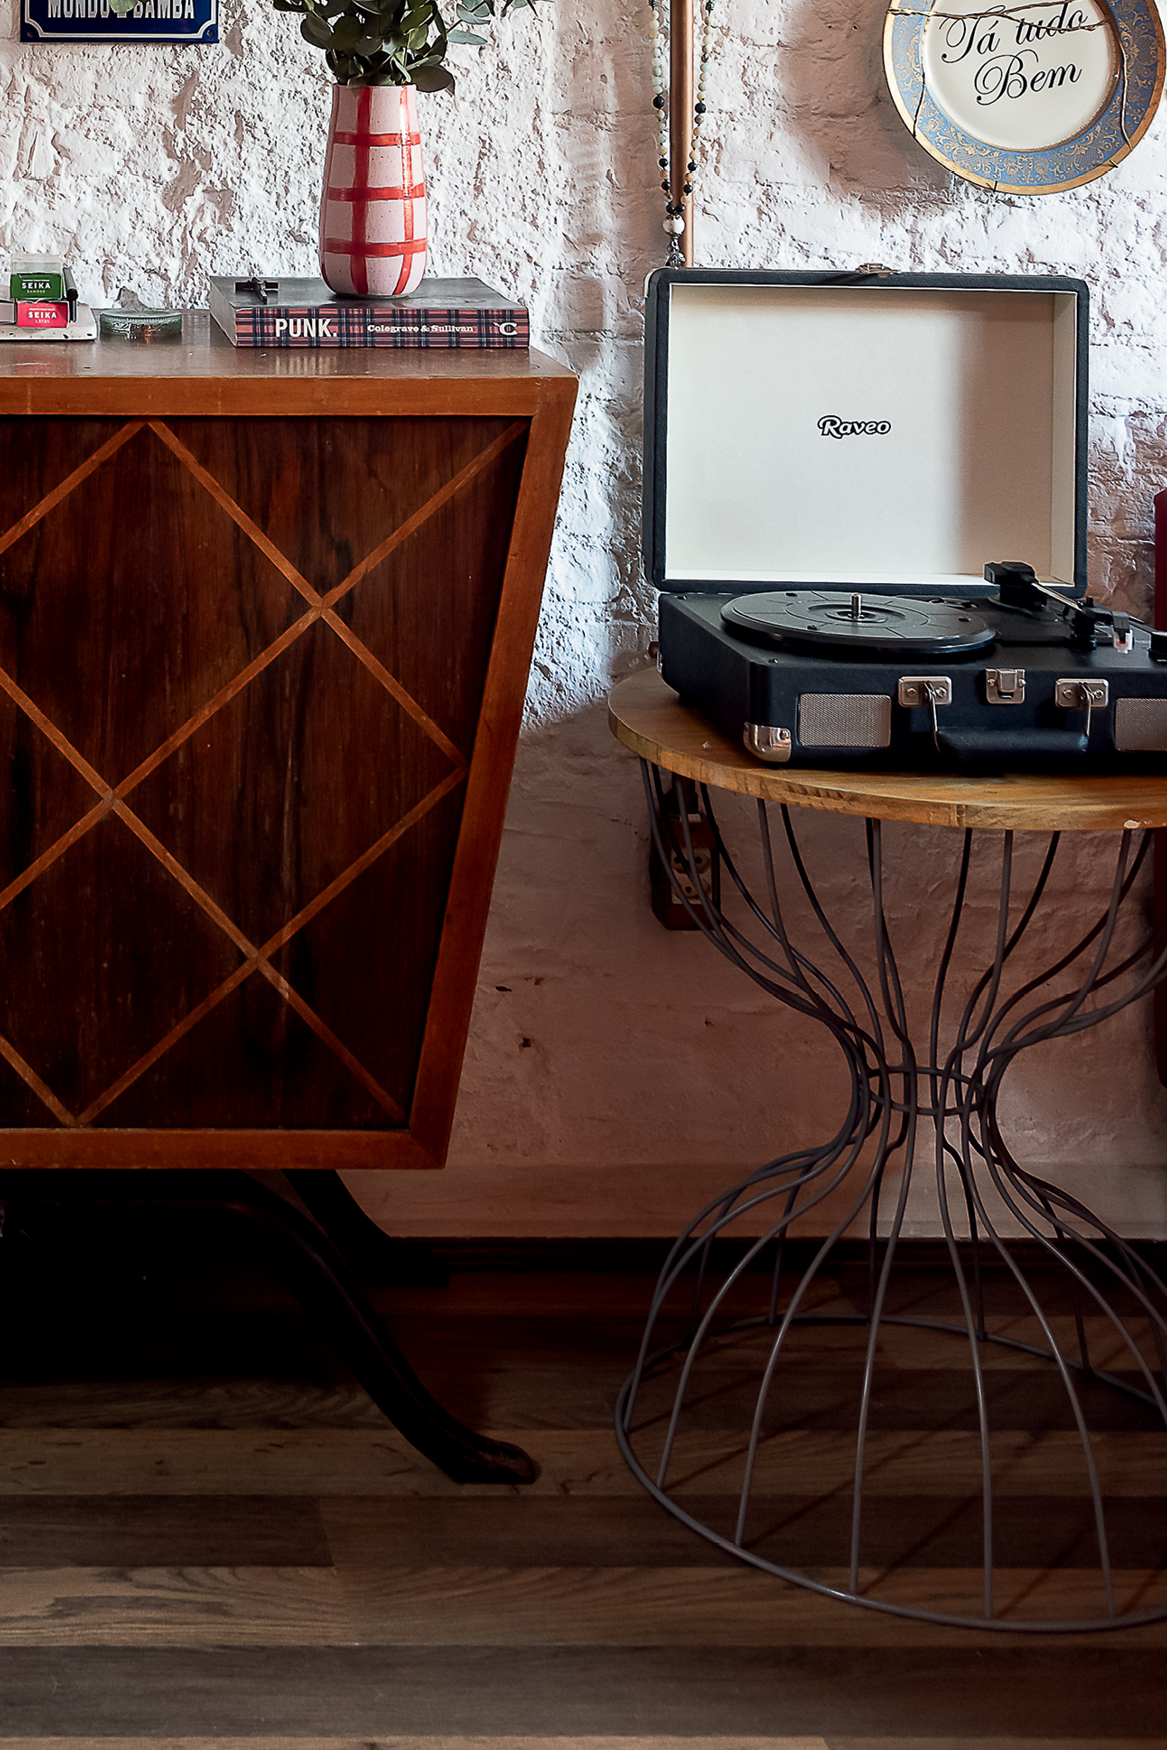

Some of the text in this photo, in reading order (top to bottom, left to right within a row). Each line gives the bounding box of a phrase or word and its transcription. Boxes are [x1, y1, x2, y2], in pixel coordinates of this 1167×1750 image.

[938, 3, 1006, 63] Tá
[974, 49, 1083, 106] Bem
[28, 311, 57, 319] SEIKA
[275, 318, 338, 338] PUNK.
[366, 324, 419, 333] Colegrave
[420, 324, 430, 333] &
[430, 324, 474, 333] Sullivan
[817, 415, 892, 439] Raveo
